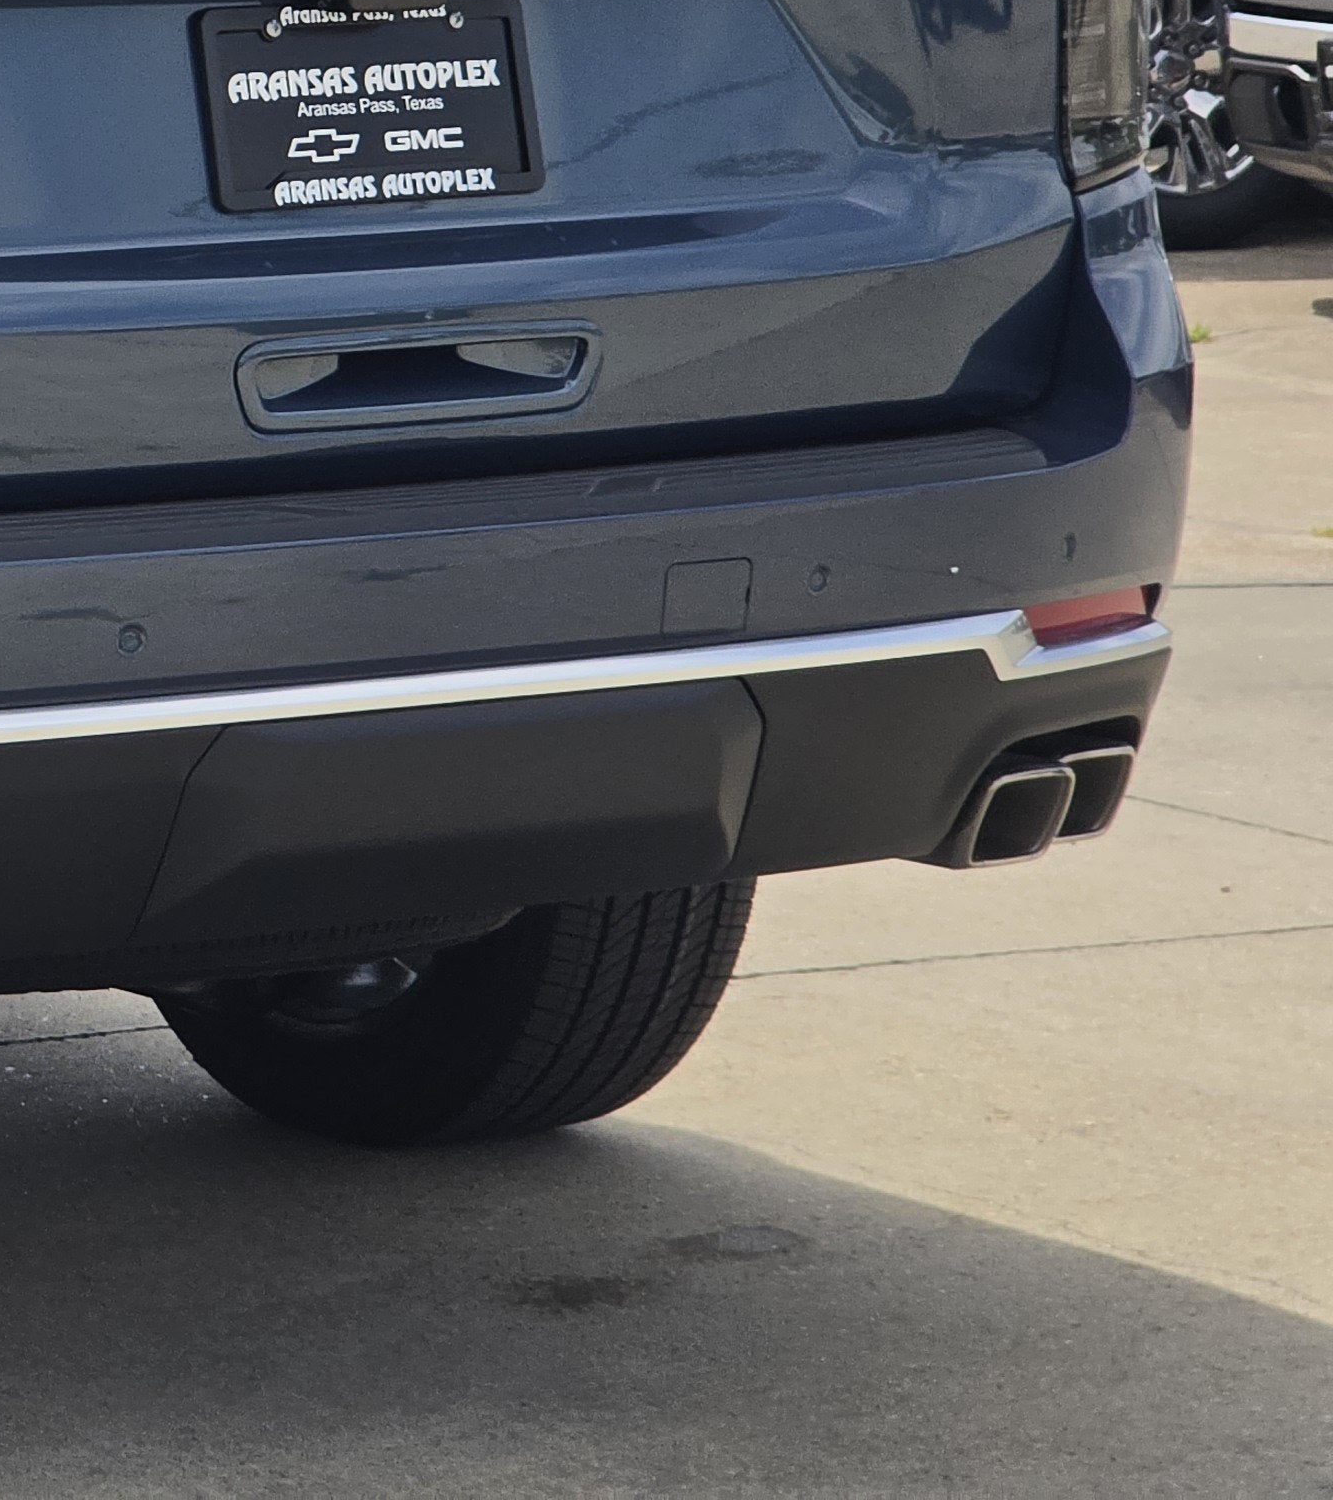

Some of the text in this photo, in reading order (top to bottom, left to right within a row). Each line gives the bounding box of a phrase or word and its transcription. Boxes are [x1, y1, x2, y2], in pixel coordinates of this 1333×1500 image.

[227, 58, 502, 104] ARANSAS AUTOPLEX
[297, 95, 445, 118] Aransas Pass, Texas
[384, 127, 465, 152] GMC
[274, 167, 497, 206] ARANSAS AUTOPLEX
